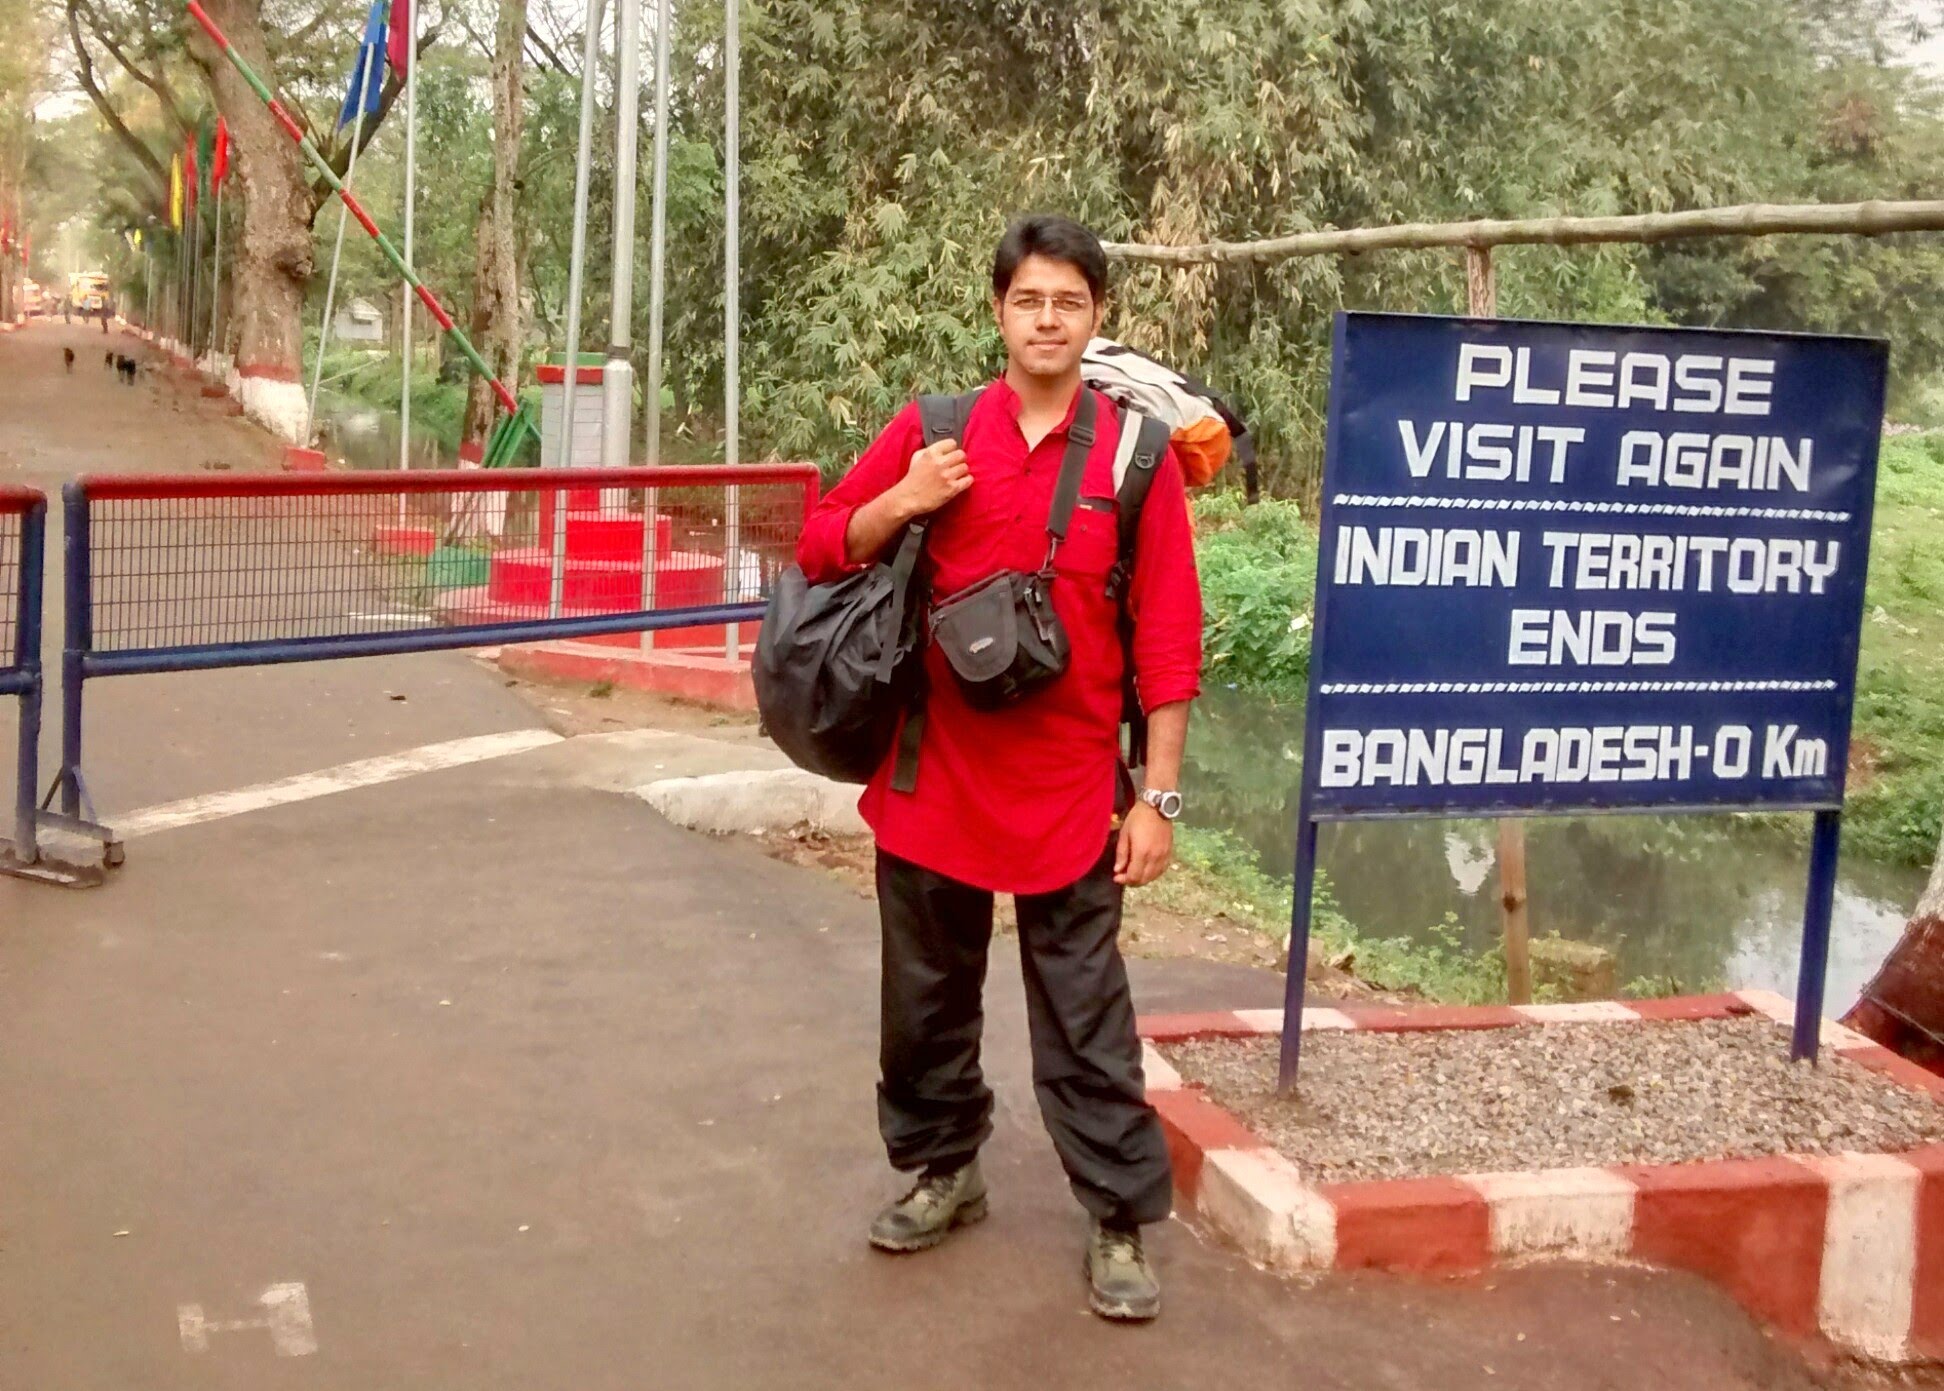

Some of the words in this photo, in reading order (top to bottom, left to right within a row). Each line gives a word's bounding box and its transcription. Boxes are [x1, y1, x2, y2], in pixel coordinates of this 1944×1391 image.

[1455, 342, 1776, 416] PLEASE
[1397, 419, 1586, 483] VISIT
[1616, 430, 1813, 493] AGAIN
[1333, 525, 1521, 588] INDIAN
[1542, 530, 1840, 595] TERRITORY
[1507, 608, 1677, 666] ENDS
[1761, 724, 1828, 779] Km
